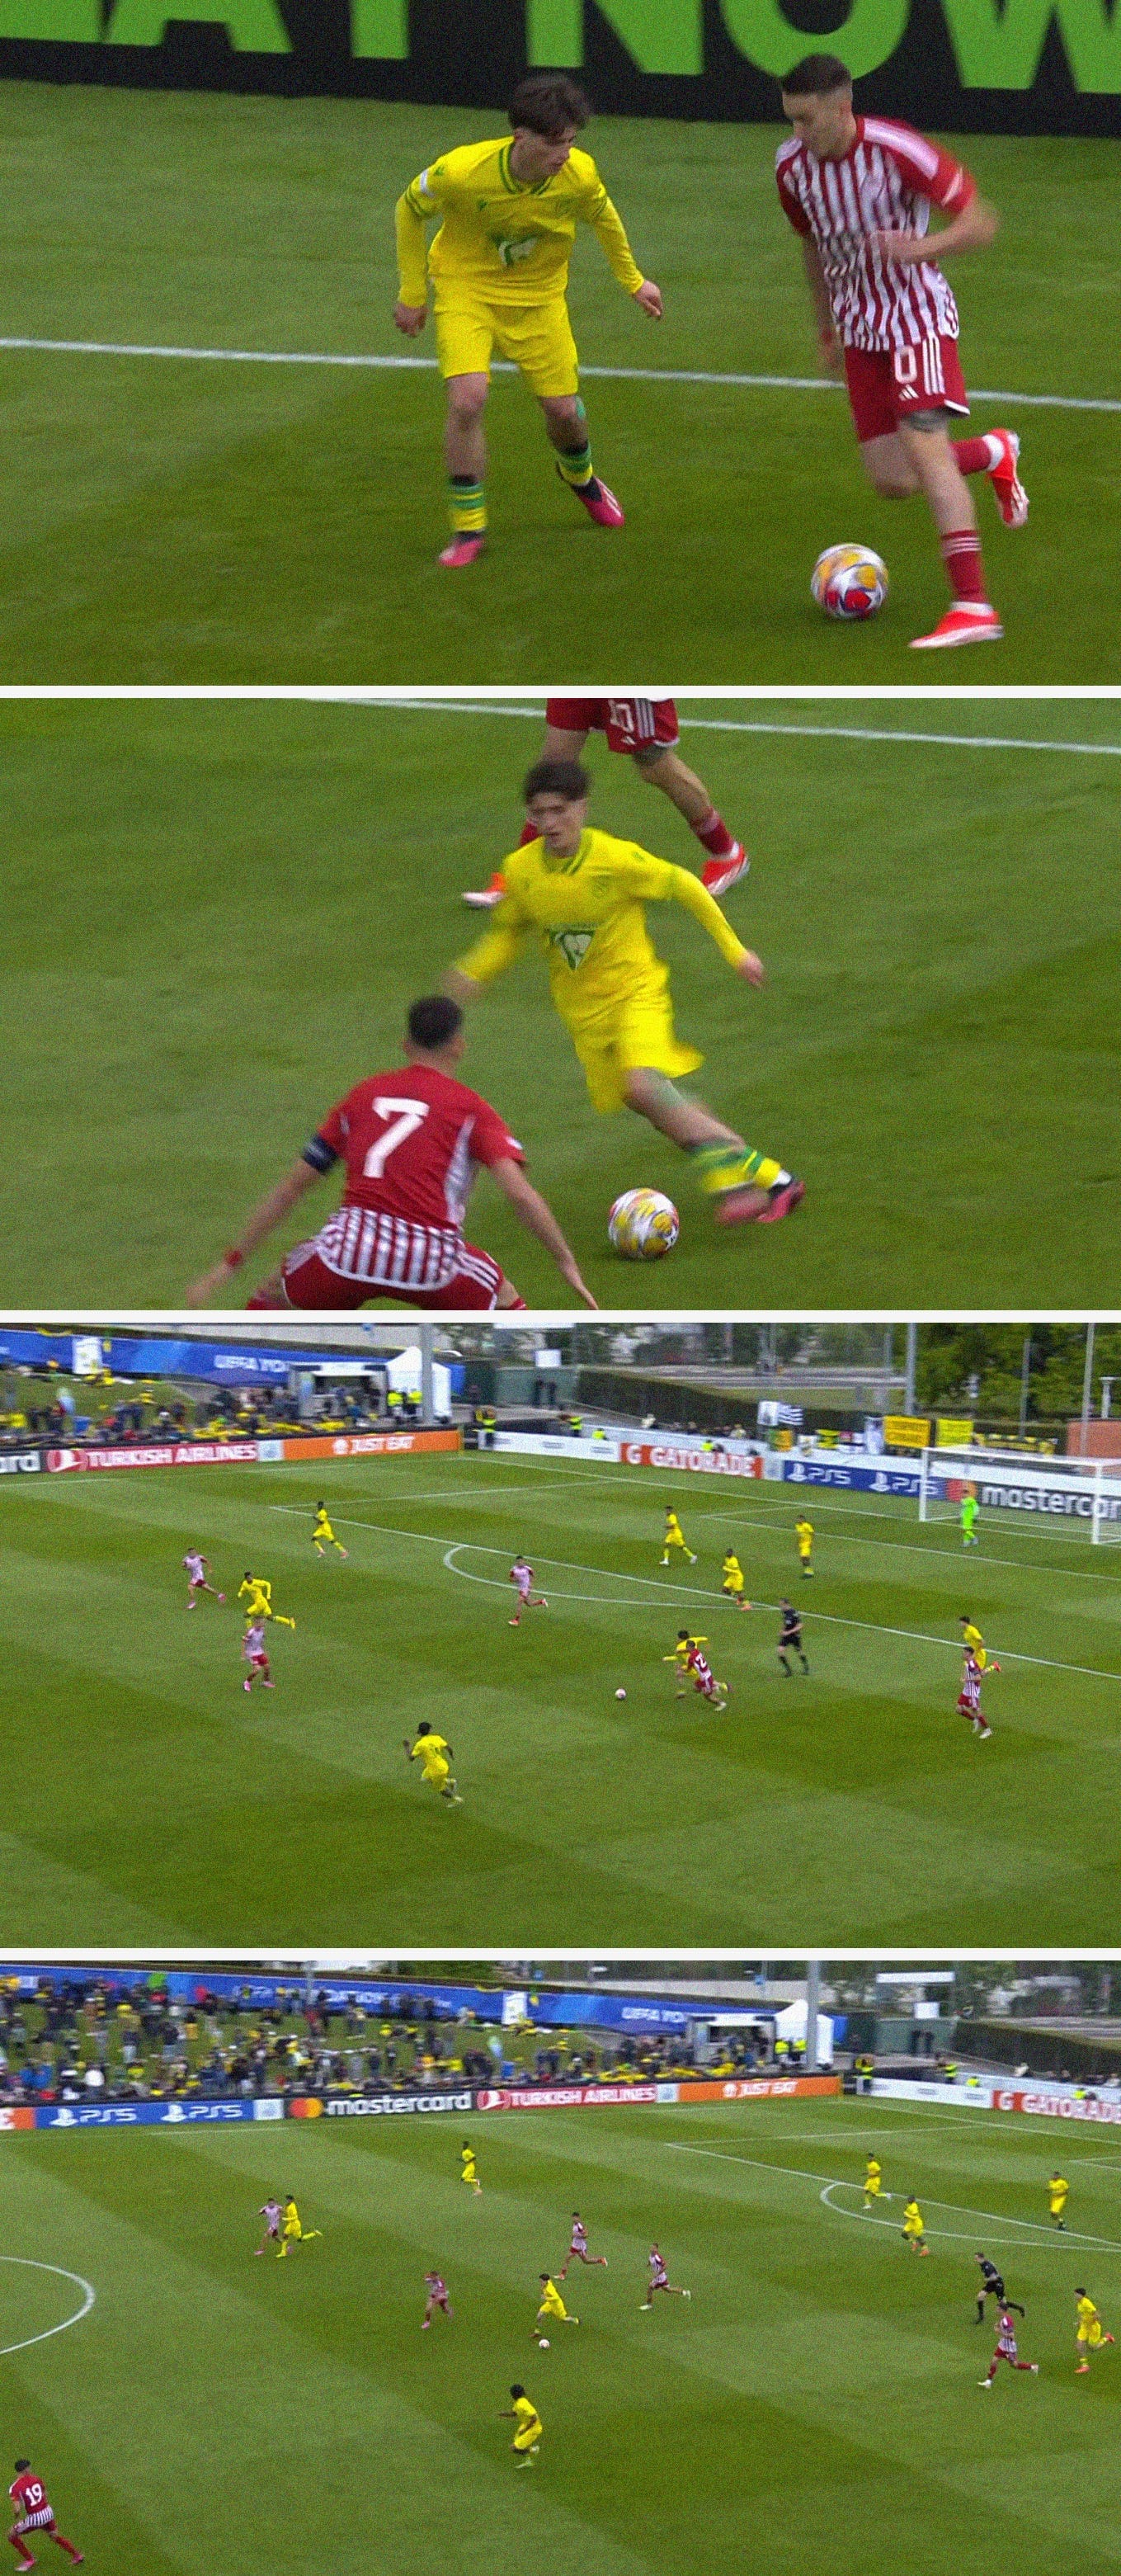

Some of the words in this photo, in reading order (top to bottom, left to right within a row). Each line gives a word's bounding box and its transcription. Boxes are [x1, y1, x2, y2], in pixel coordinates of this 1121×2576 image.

[363, 1096, 430, 1179] 7
[351, 1437, 384, 1453] JUST
[386, 1436, 416, 1451] EAT
[87, 1446, 172, 1468] TURKISH
[175, 1443, 257, 1464] AIRLINES
[650, 1446, 756, 1477] GATORADE
[809, 1467, 851, 1485] PS5
[893, 1476, 939, 1495] PS5
[510, 2090, 581, 2108] TURKISH
[584, 2088, 657, 2104] AIRLINES
[739, 2083, 769, 2097] JUST
[185, 2104, 243, 2120] PS5
[327, 2092, 472, 2116] mastercard
[79, 2107, 137, 2123] PS5
[26, 2483, 42, 2508] 19
